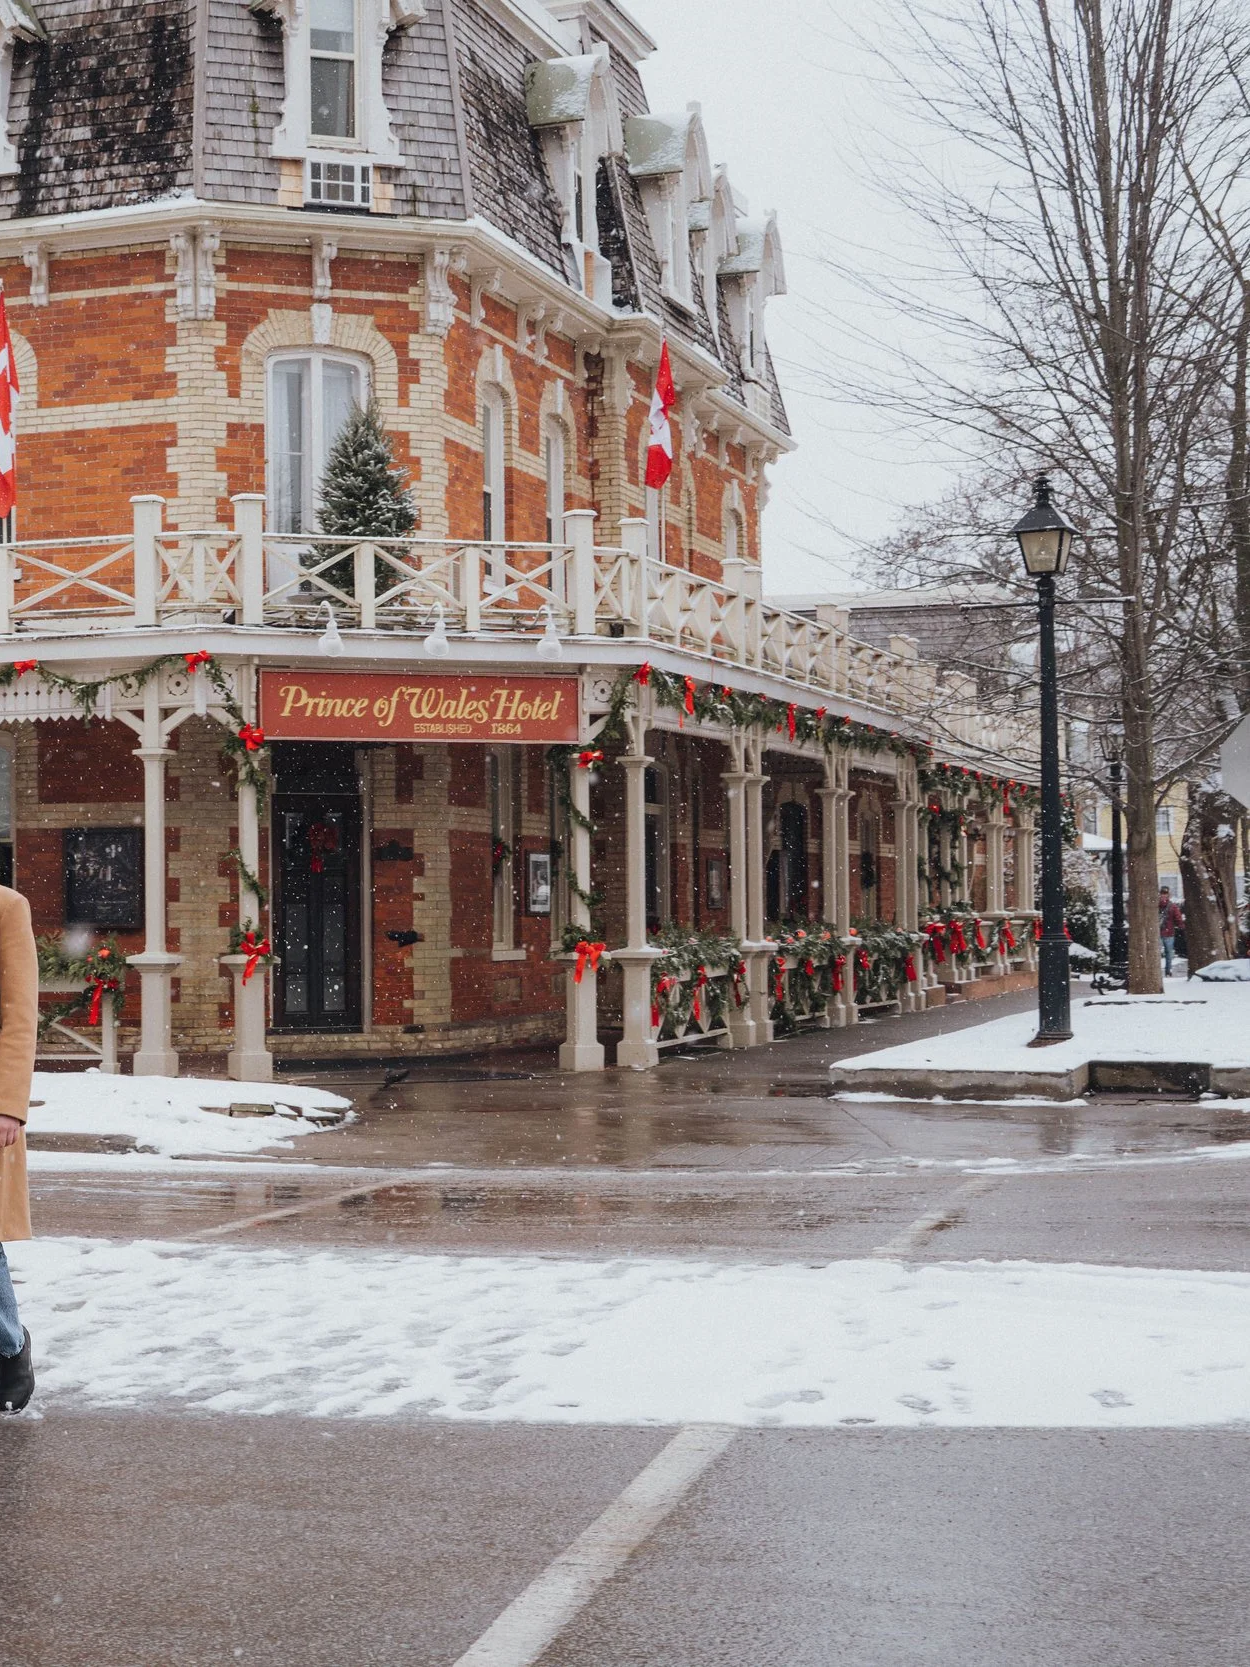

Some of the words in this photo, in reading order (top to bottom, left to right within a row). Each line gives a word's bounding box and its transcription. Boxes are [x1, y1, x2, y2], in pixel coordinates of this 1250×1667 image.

[280, 685, 368, 717] Prince
[373, 686, 406, 727] of
[404, 687, 490, 723] Wales
[490, 689, 560, 720] Hotel
[413, 723, 473, 734] ESTABLISHED
[491, 723, 522, 735] 1864
